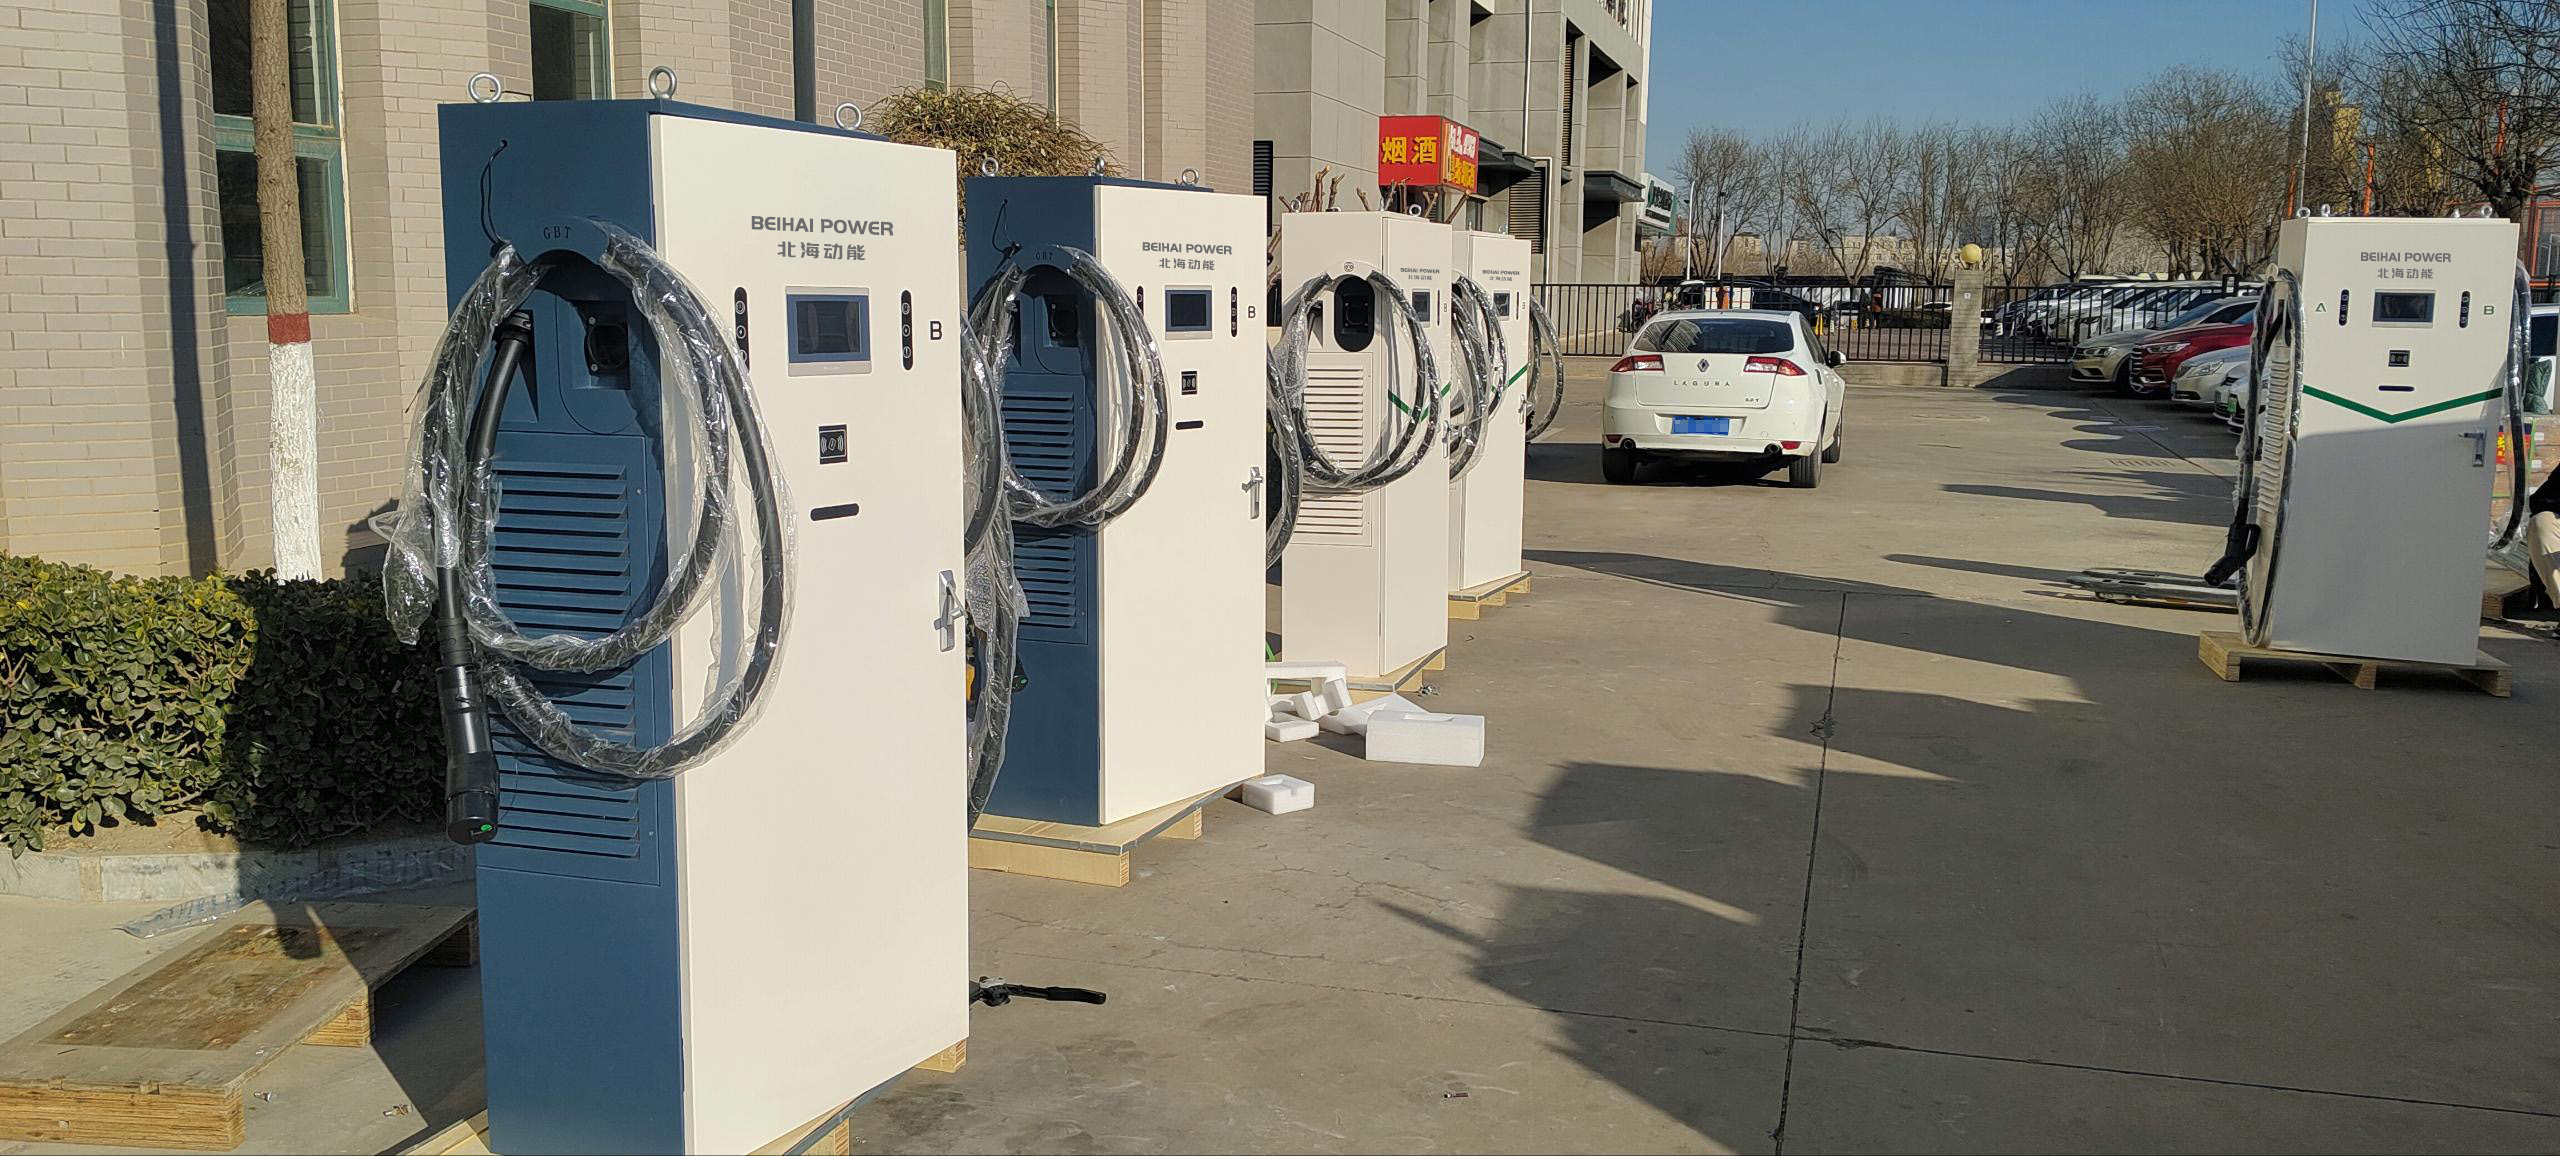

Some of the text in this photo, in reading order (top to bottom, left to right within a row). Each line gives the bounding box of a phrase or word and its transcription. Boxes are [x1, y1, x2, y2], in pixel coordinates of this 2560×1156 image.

[1381, 136, 1438, 164] 烟酒
[543, 225, 571, 240] GBT
[751, 215, 894, 236] BEIHAI POWER
[777, 241, 866, 261] 北海动能
[1142, 241, 1233, 255] BEIHAI POWER
[1158, 258, 1215, 270] 北海动能
[2360, 251, 2452, 263] BEIHAI POWER
[2377, 268, 2434, 279] 北海动能
[1247, 305, 1256, 319] B
[2315, 302, 2327, 312] A
[2483, 305, 2495, 315] B
[930, 320, 943, 340] B
